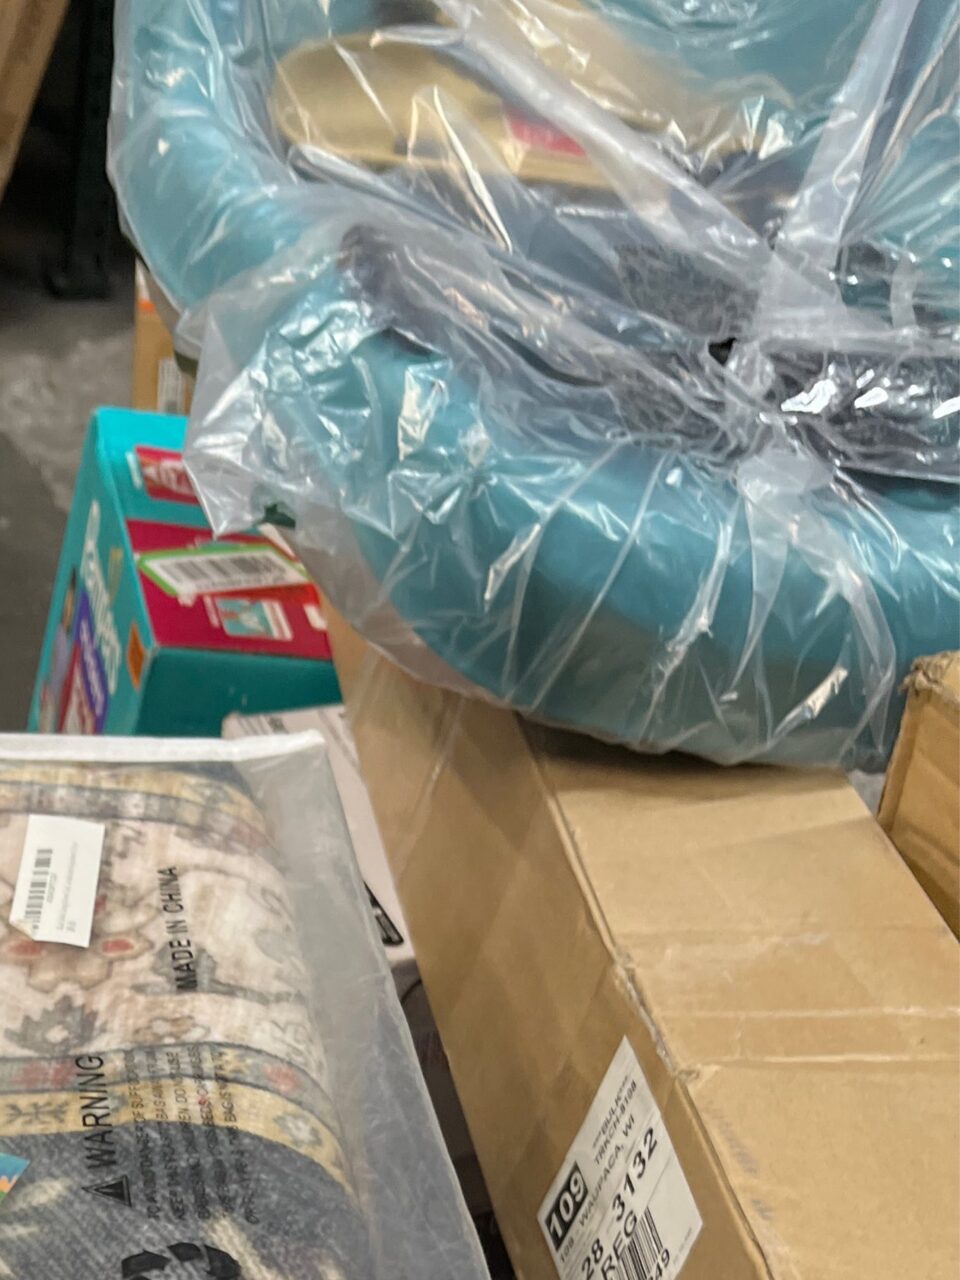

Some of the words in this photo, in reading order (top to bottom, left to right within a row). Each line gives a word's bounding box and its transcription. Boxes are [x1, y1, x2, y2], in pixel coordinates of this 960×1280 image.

[157, 866, 184, 913] CHINA
[169, 939, 198, 990] MADE
[75, 1055, 117, 1169] WARNING
[550, 1171, 584, 1240] 109
[612, 1126, 658, 1222] 3132
